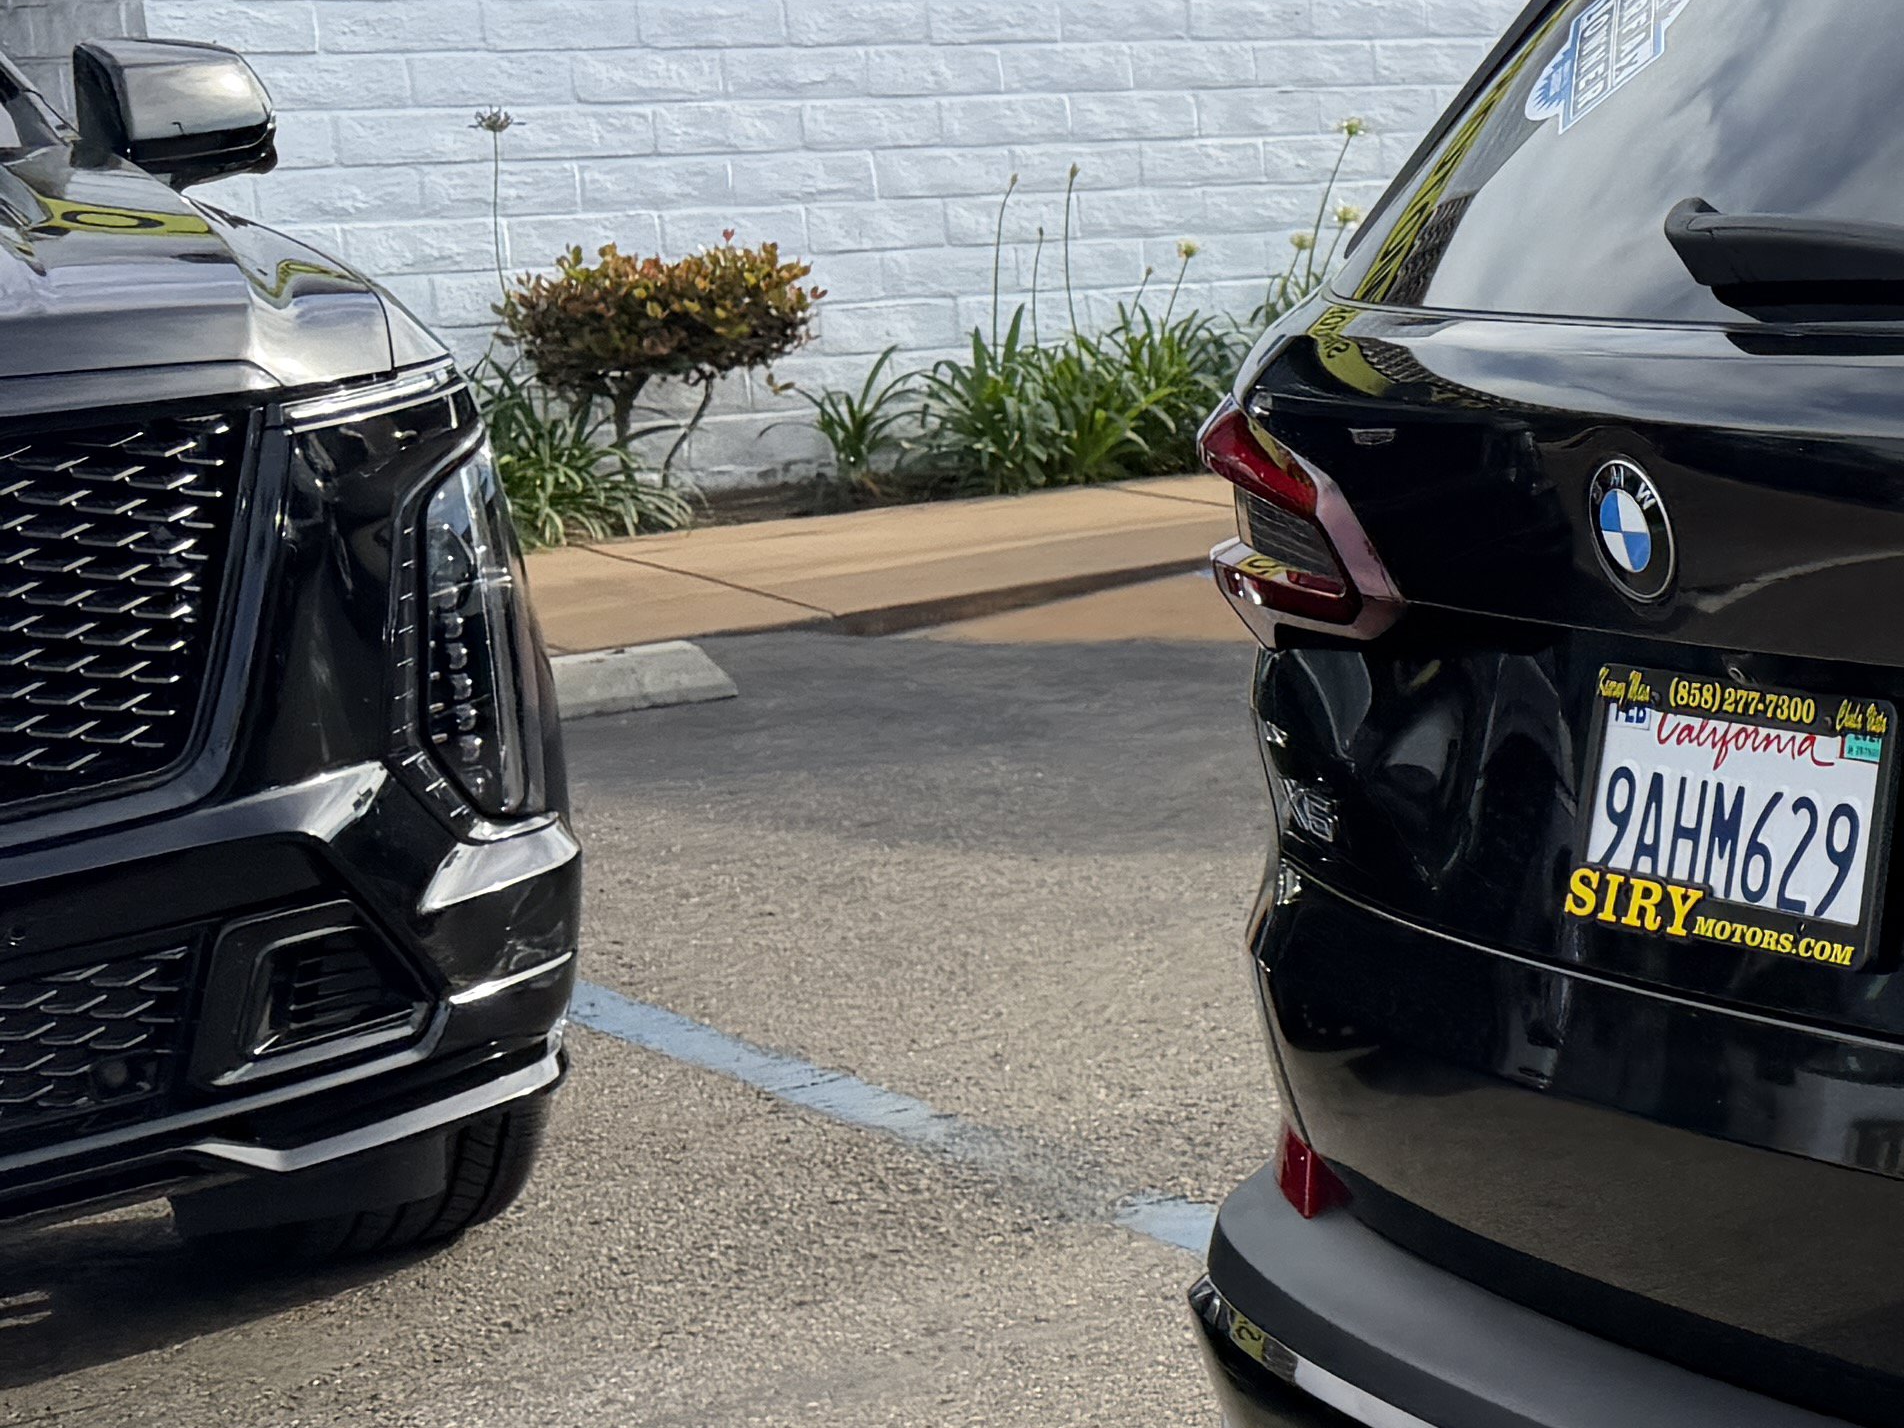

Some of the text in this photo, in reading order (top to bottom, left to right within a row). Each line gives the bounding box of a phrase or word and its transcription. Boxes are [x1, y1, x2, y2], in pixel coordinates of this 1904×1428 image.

[1592, 464, 1657, 510] BMW
[1722, 689, 1816, 724] 277-7300
[1656, 711, 1836, 772] California
[1602, 766, 1860, 917] 9AHM629
[1564, 867, 1704, 938] SIRY
[1693, 915, 1855, 967] MOTORS.COM
